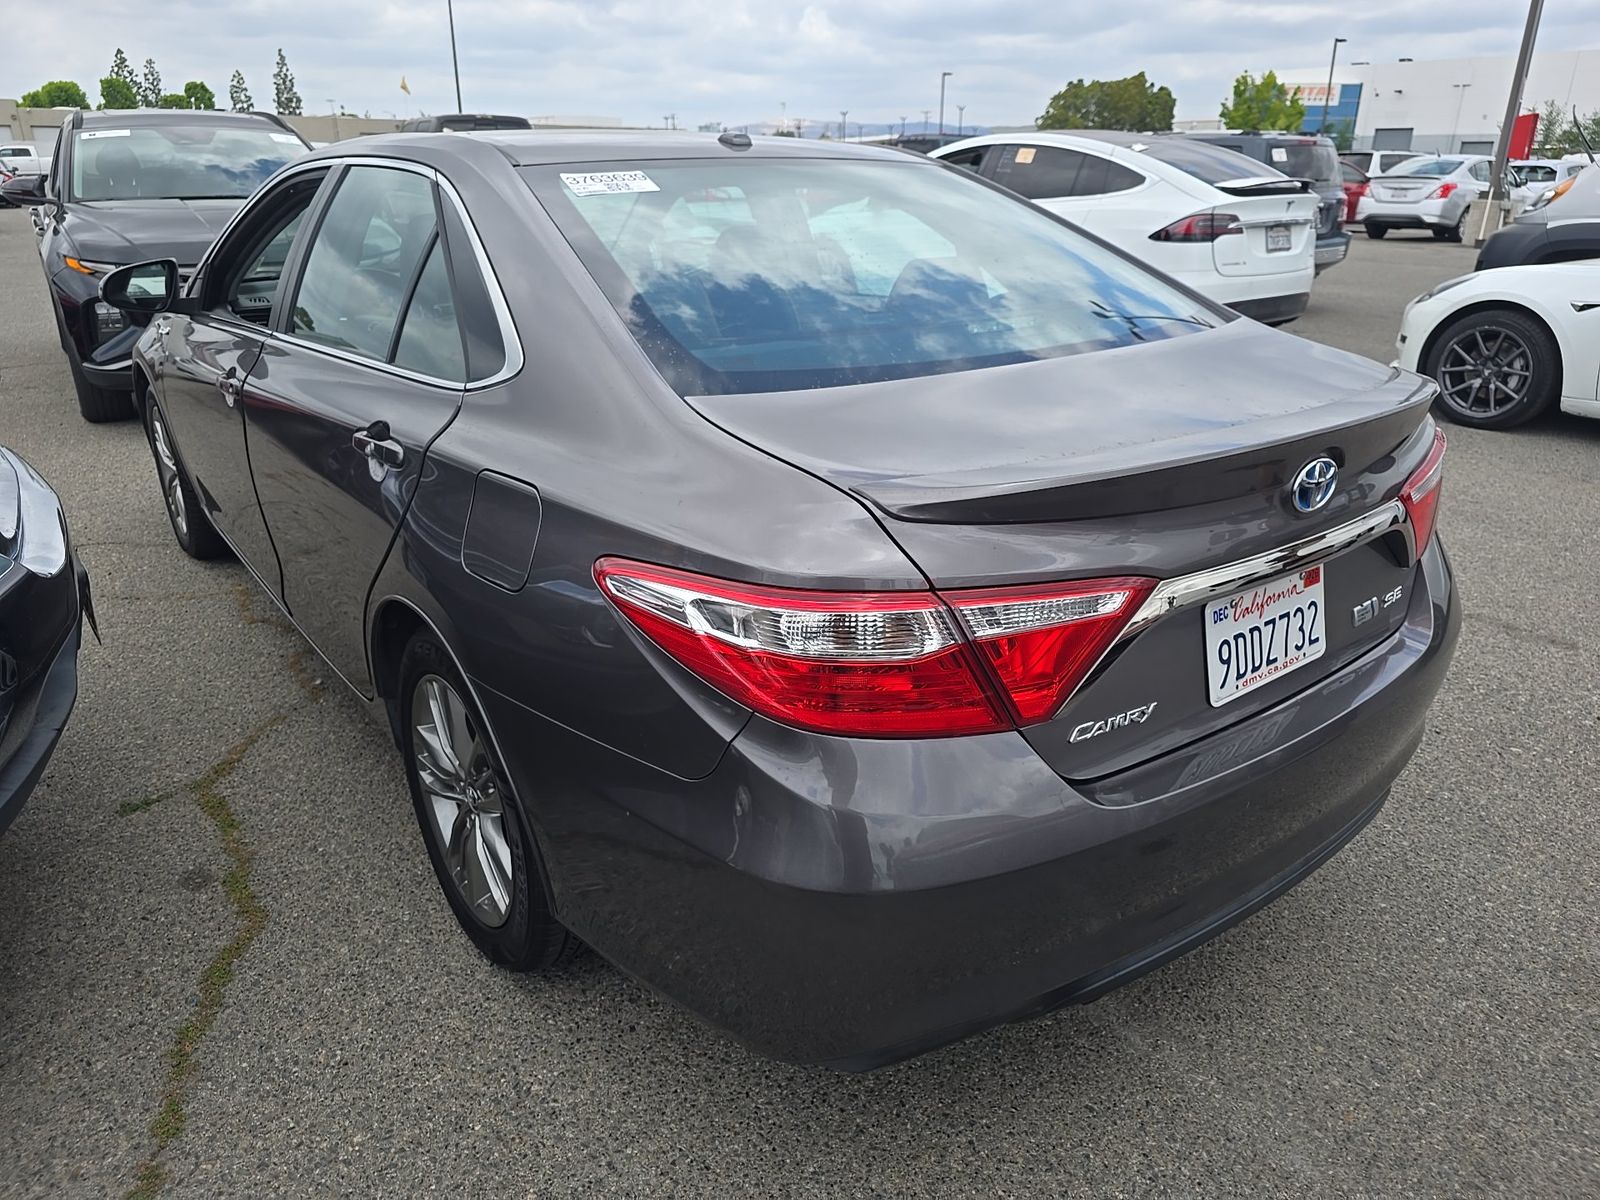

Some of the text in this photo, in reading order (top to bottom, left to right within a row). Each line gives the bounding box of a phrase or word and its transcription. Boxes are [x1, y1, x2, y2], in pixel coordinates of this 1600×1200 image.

[566, 173, 648, 185] 3763639
[1213, 580, 1305, 625] DEC California
[1384, 585, 1403, 608] SE
[1217, 600, 1320, 690] 9DDZ732
[1242, 654, 1301, 688] dmv.ca.gov
[1068, 702, 1158, 743] CAMRY
